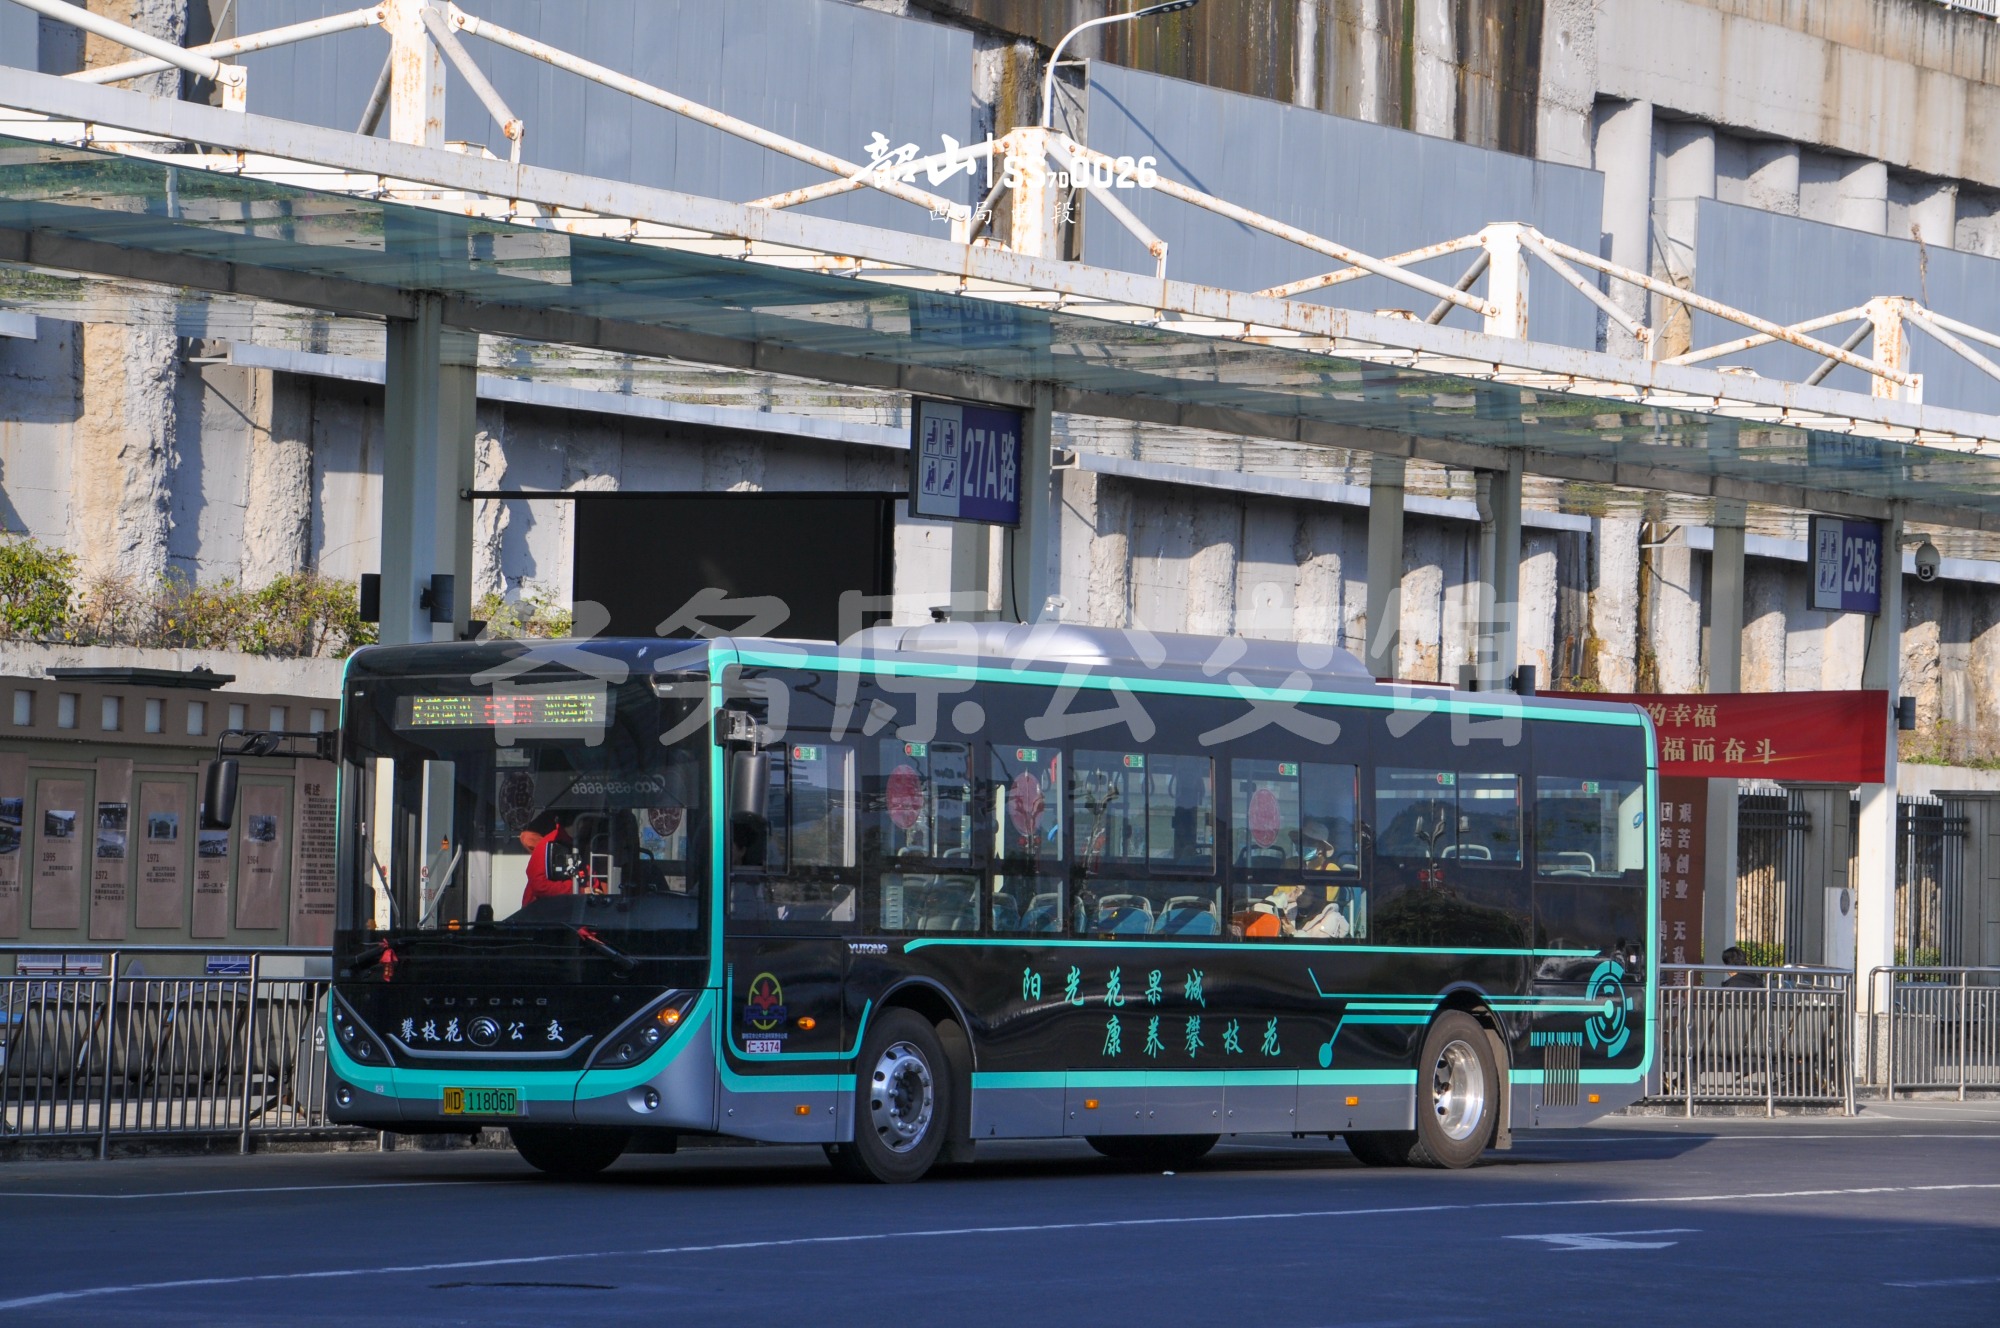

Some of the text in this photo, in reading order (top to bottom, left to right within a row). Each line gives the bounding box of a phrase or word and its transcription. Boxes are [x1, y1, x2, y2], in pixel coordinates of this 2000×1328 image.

[963, 428, 1016, 502] 27A路
[1844, 537, 1877, 594] 25路
[1645, 703, 1718, 728] 的幸福
[1661, 736, 1777, 764] 福而奋斗
[1675, 803, 1692, 899] 艰苦创业
[848, 943, 889, 955] YUTONG
[423, 997, 548, 1006] YUTONG
[1022, 965, 1206, 1008] 阳光花果城
[400, 1016, 565, 1043] 攀枝花 公交
[1102, 1014, 1281, 1059] 康养攀枝花
